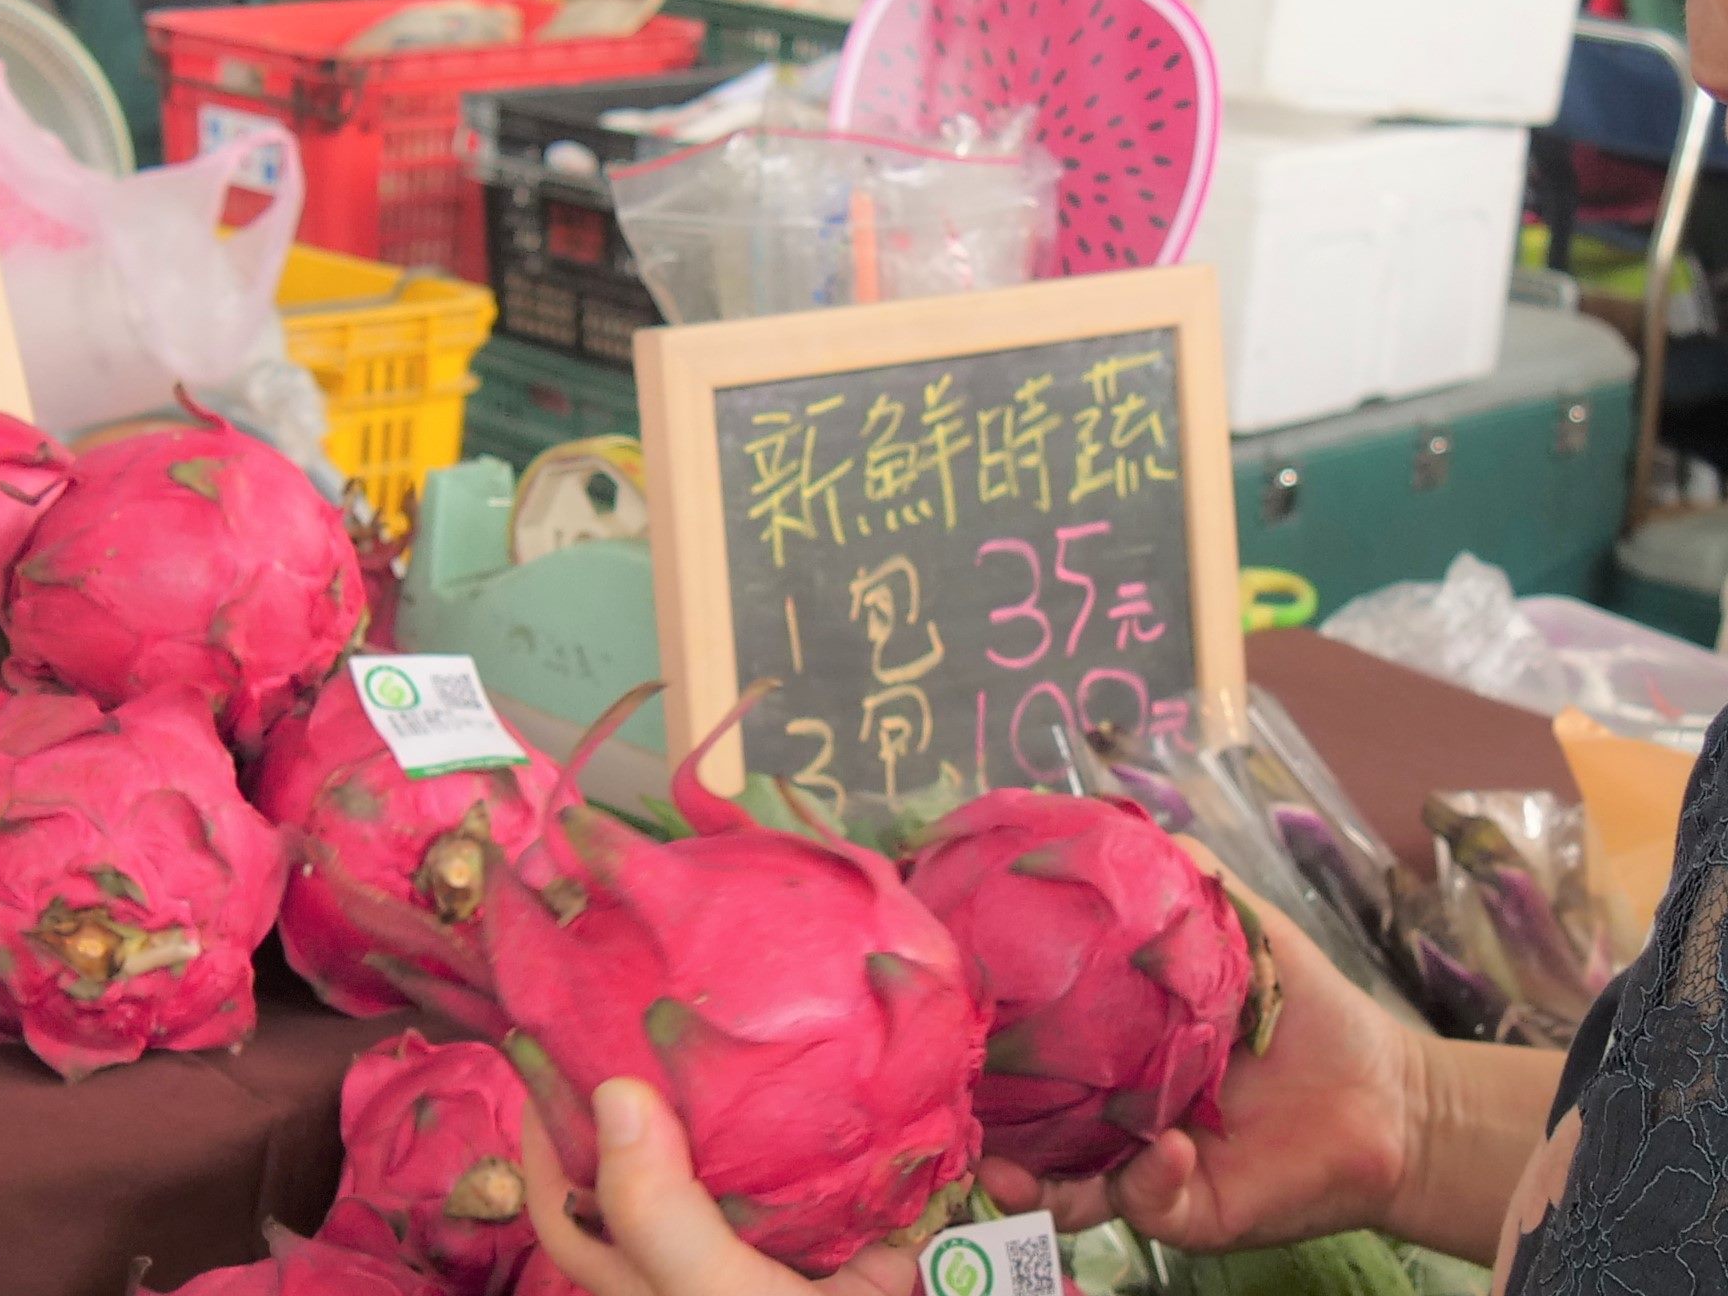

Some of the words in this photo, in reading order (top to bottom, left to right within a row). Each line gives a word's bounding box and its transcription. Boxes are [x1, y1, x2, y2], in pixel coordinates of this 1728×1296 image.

[744, 353, 1177, 566] 新鮮時蔬
[975, 521, 1166, 670] 35元
